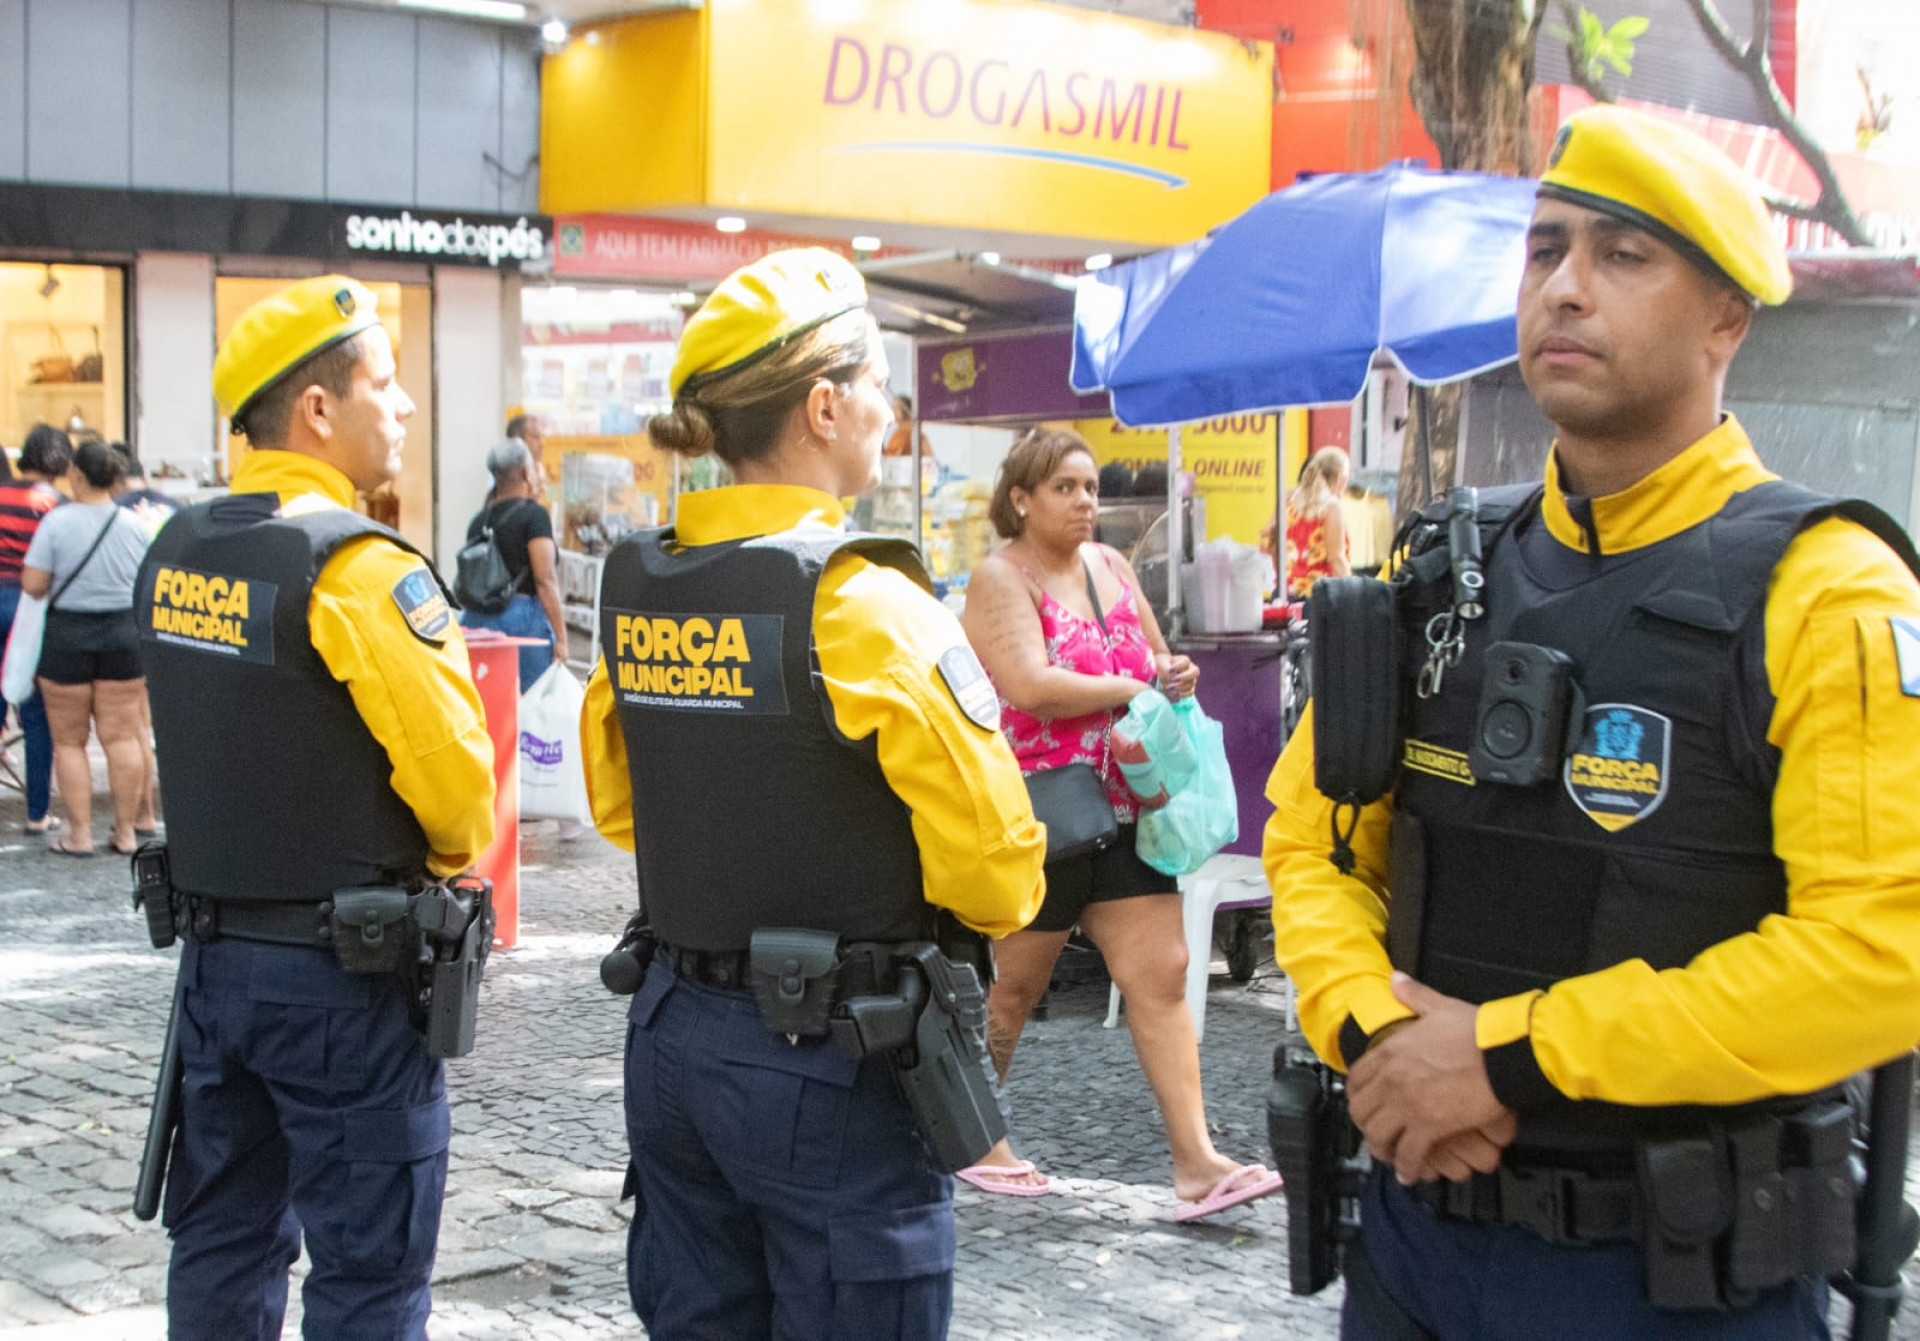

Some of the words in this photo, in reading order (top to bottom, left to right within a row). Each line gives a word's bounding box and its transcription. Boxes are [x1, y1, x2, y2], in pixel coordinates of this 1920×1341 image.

[823, 35, 1190, 152] DROGASMIL
[595, 230, 637, 260] AQUI
[642, 232, 678, 262] TEM
[1193, 457, 1267, 478] ONLINE
[153, 567, 249, 619] FORÇA
[152, 605, 248, 648] MUNICIPAL
[616, 614, 751, 668] FORÇA
[617, 661, 754, 697] MUNICIPAL
[1572, 753, 1660, 784] FORÇA
